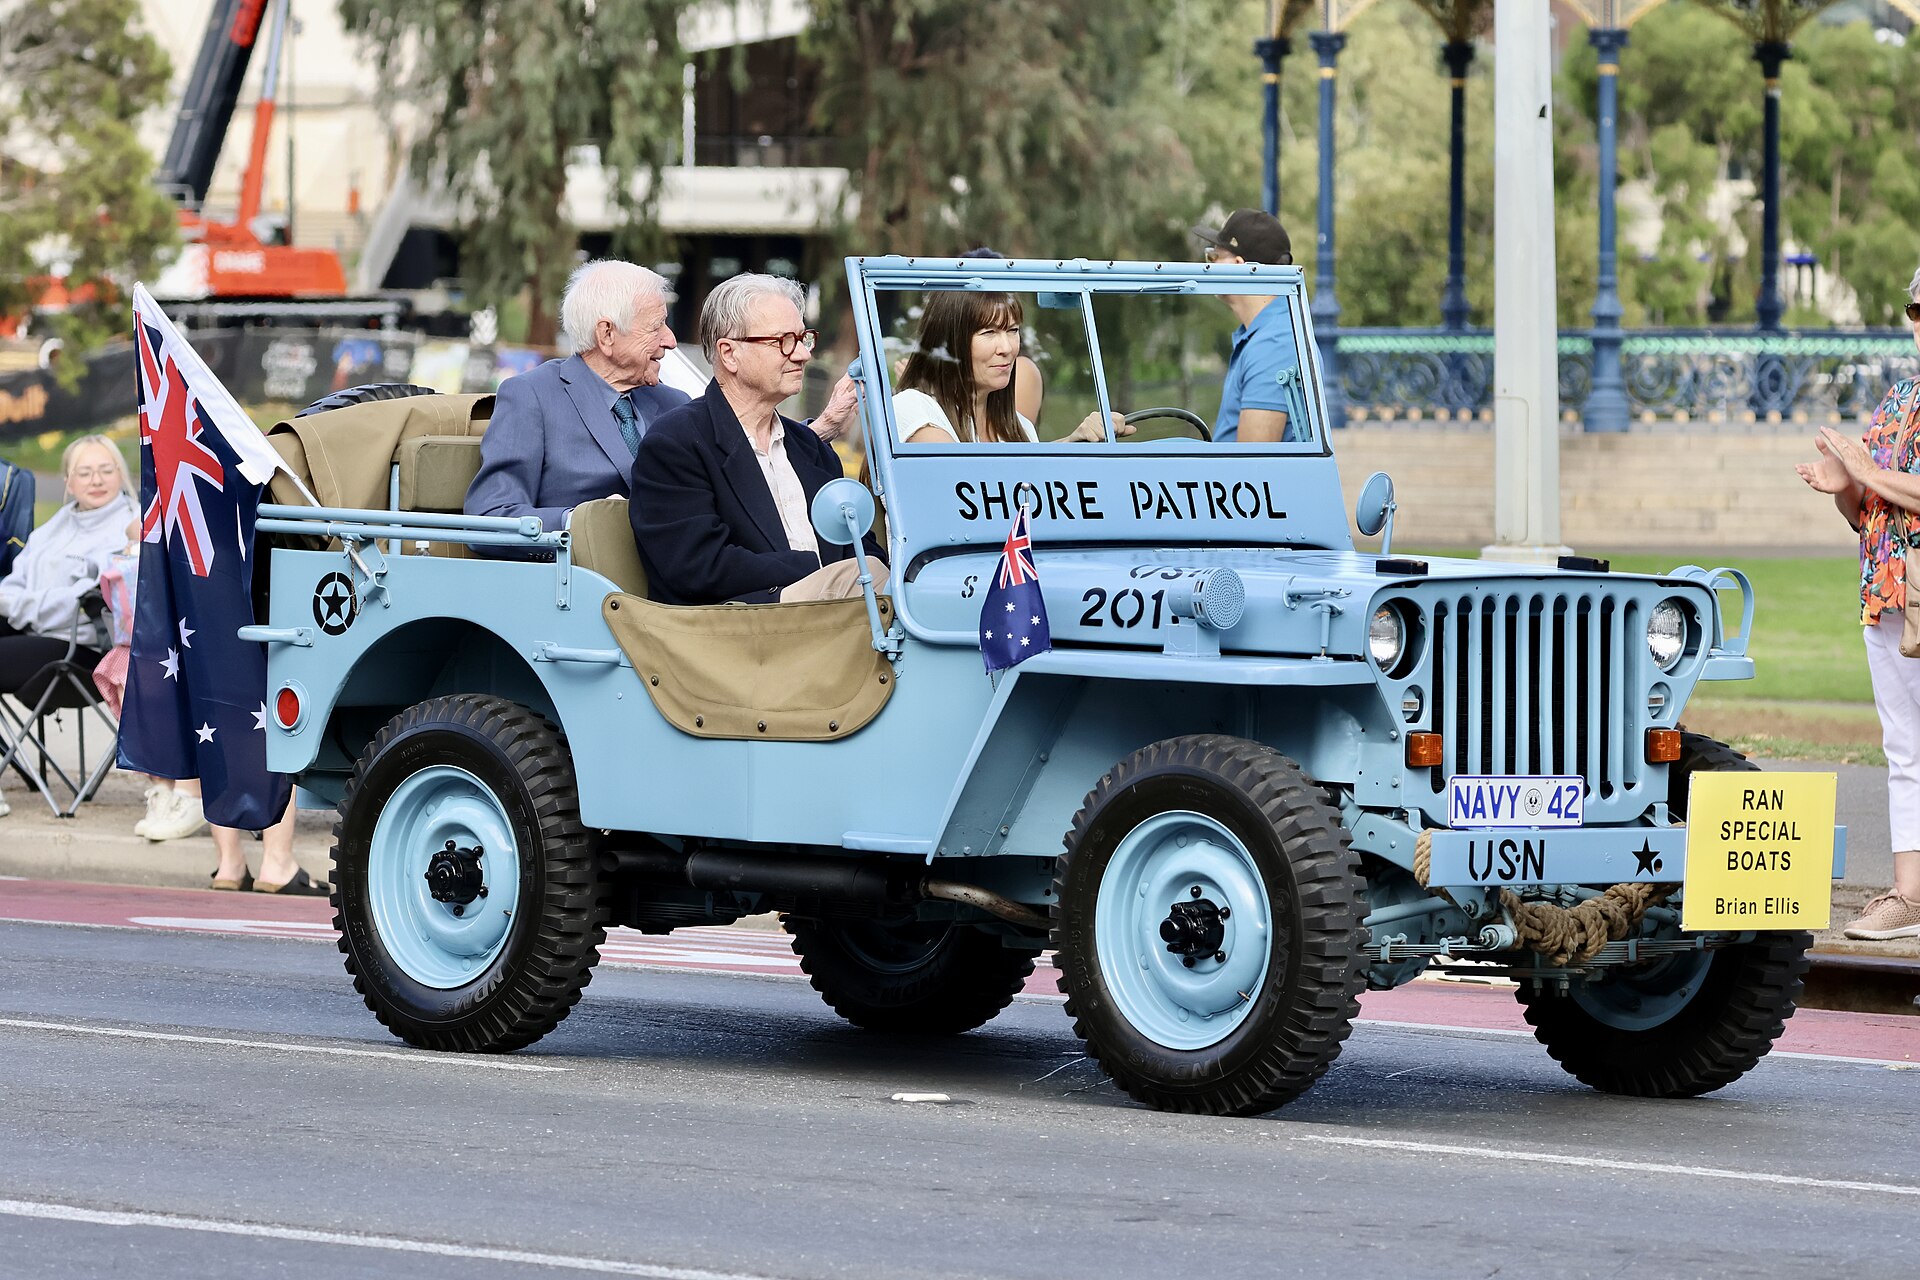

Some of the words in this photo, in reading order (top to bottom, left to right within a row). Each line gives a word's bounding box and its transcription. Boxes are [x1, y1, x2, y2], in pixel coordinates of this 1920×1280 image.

[955, 481, 1104, 520] SHORE
[1129, 481, 1287, 520] PATROL
[1130, 564, 1203, 580] US
[1079, 587, 1180, 630] 201
[1454, 785, 1521, 819] NAVY
[1547, 785, 1580, 819] 42
[1742, 789, 1784, 811] RAN
[1720, 820, 1801, 841] SPECIAL
[1727, 850, 1791, 871] BOATS
[1715, 897, 1757, 915] Brian
[1764, 897, 1800, 915] Ellis
[437, 966, 504, 1016] NDMS
